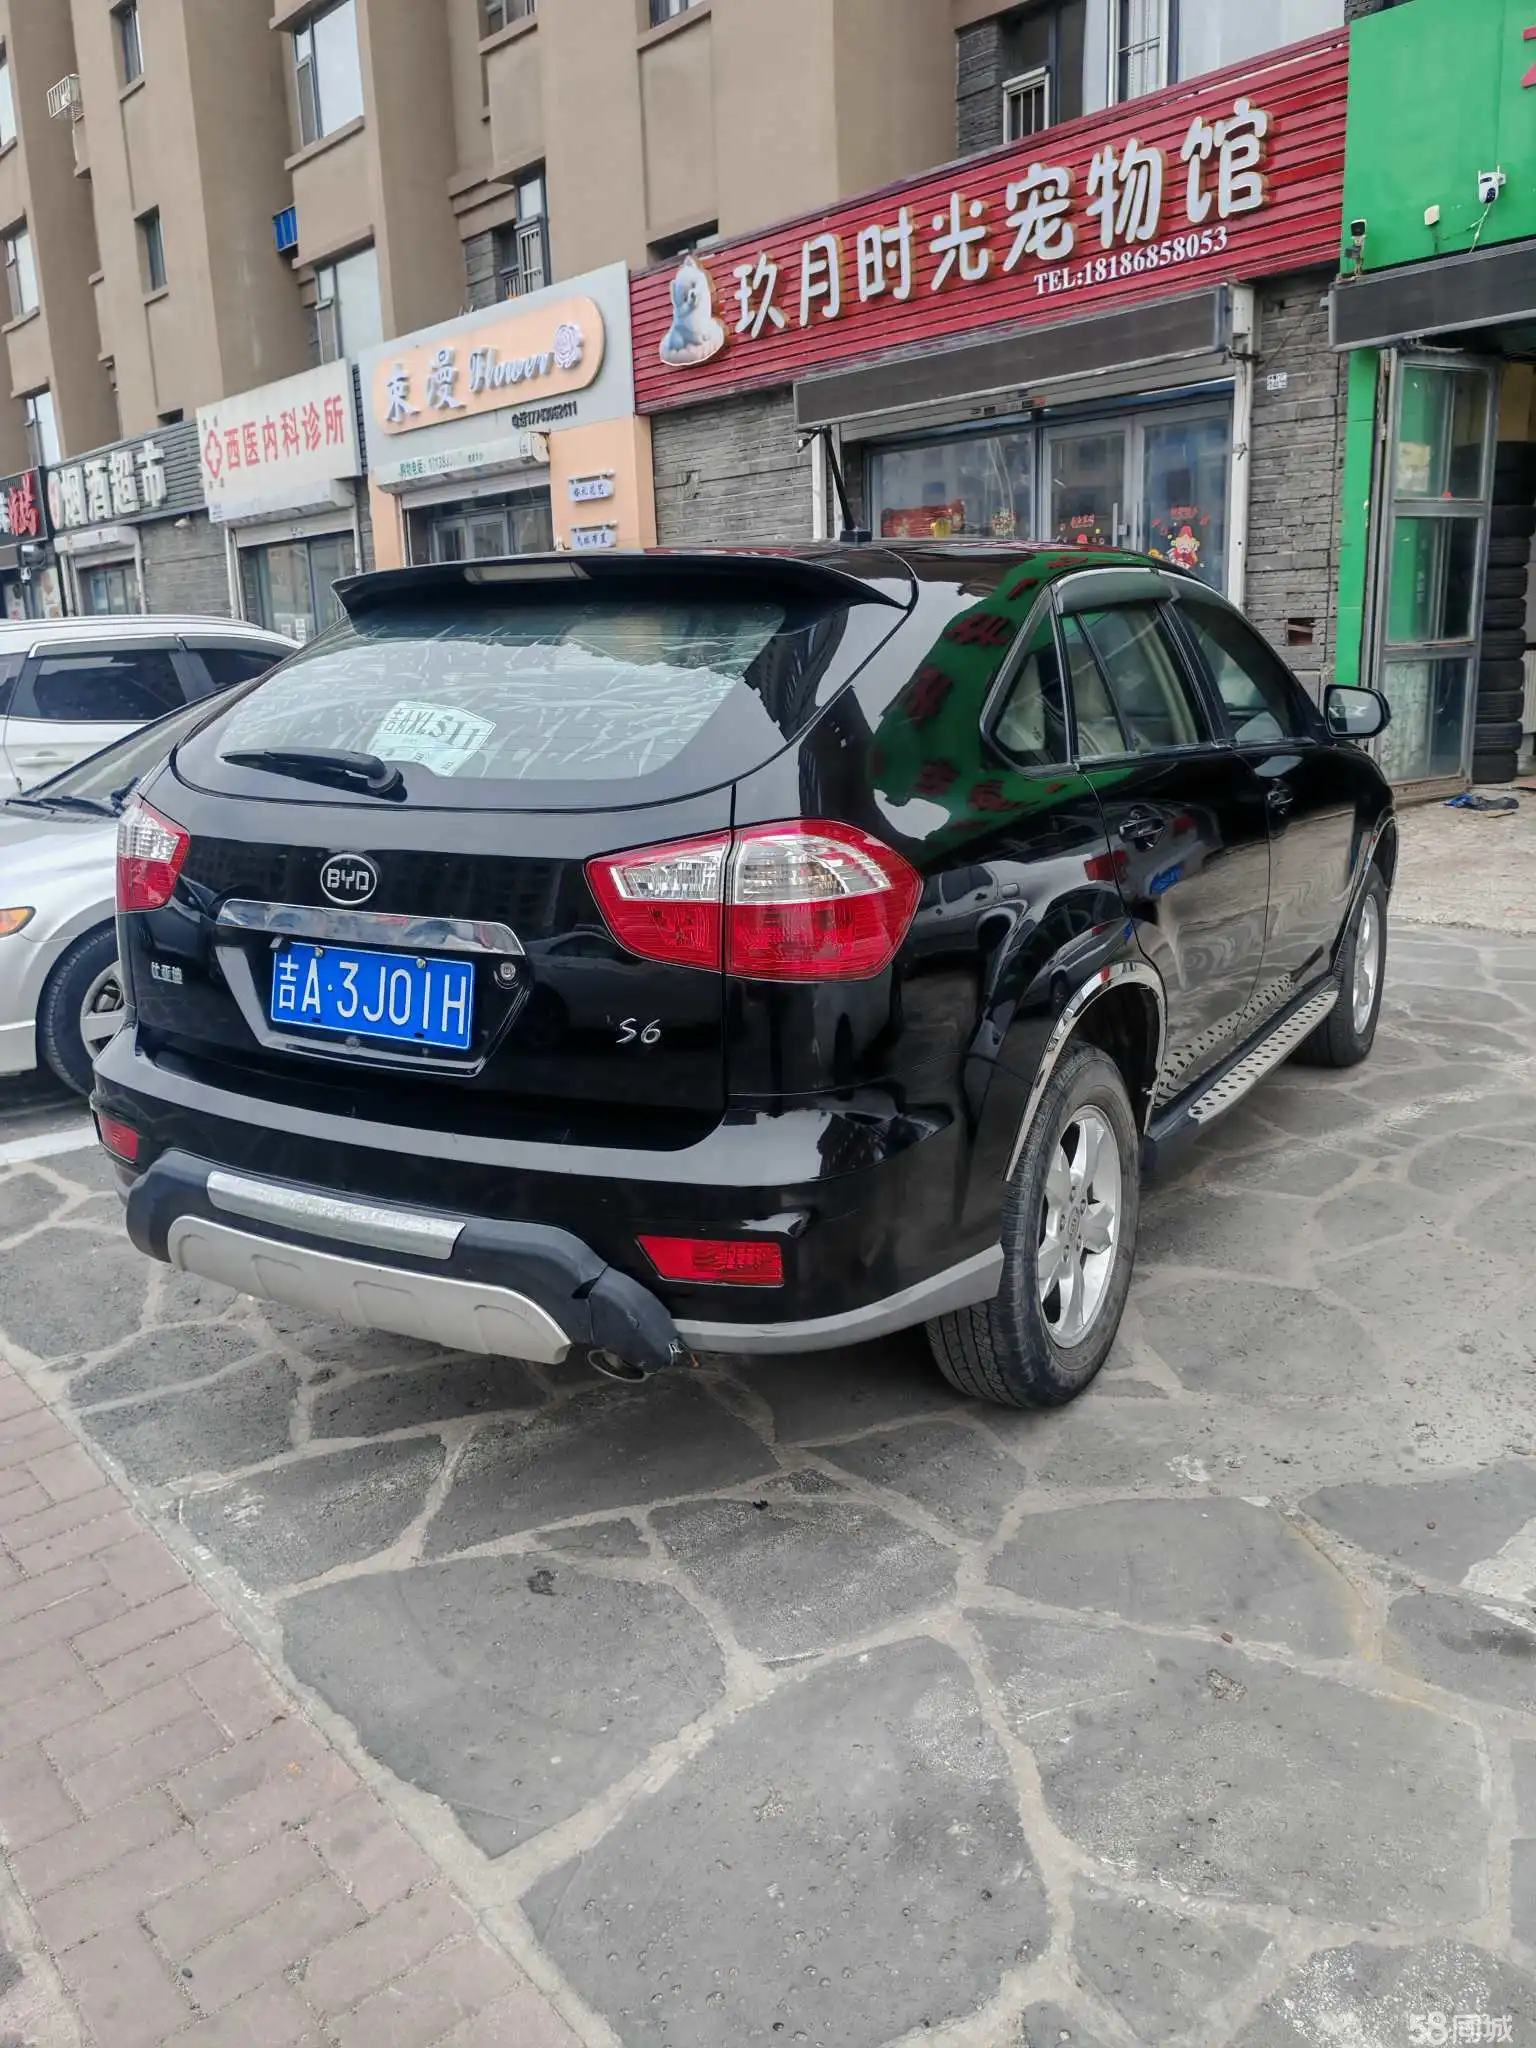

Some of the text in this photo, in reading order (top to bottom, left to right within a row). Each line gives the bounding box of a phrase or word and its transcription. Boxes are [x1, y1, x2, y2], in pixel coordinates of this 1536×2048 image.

[732, 98, 1274, 340] 玖月时光宠物馆
[1033, 226, 1230, 296] TEL:18186858053
[223, 394, 345, 470] 西医内科诊所
[62, 440, 167, 527] 烟酒超市
[326, 868, 371, 891] BYD
[615, 1017, 662, 1045] S6
